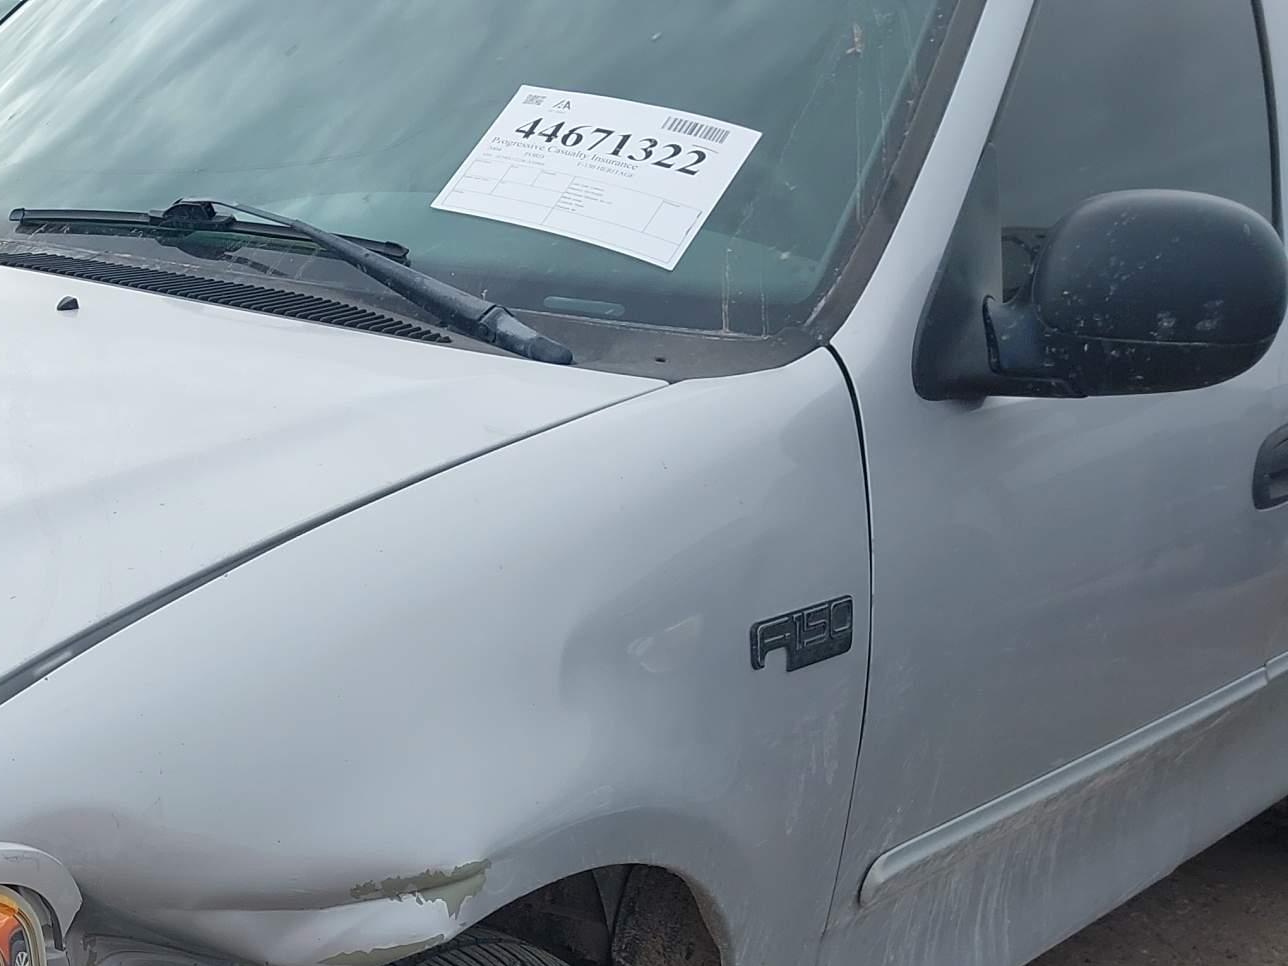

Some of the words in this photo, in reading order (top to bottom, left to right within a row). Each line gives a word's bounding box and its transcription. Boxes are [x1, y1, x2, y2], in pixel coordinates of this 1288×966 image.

[491, 136, 546, 153] Progressive
[547, 144, 588, 161] Casualty
[591, 153, 639, 170] Insurance
[514, 117, 706, 176] 44671322
